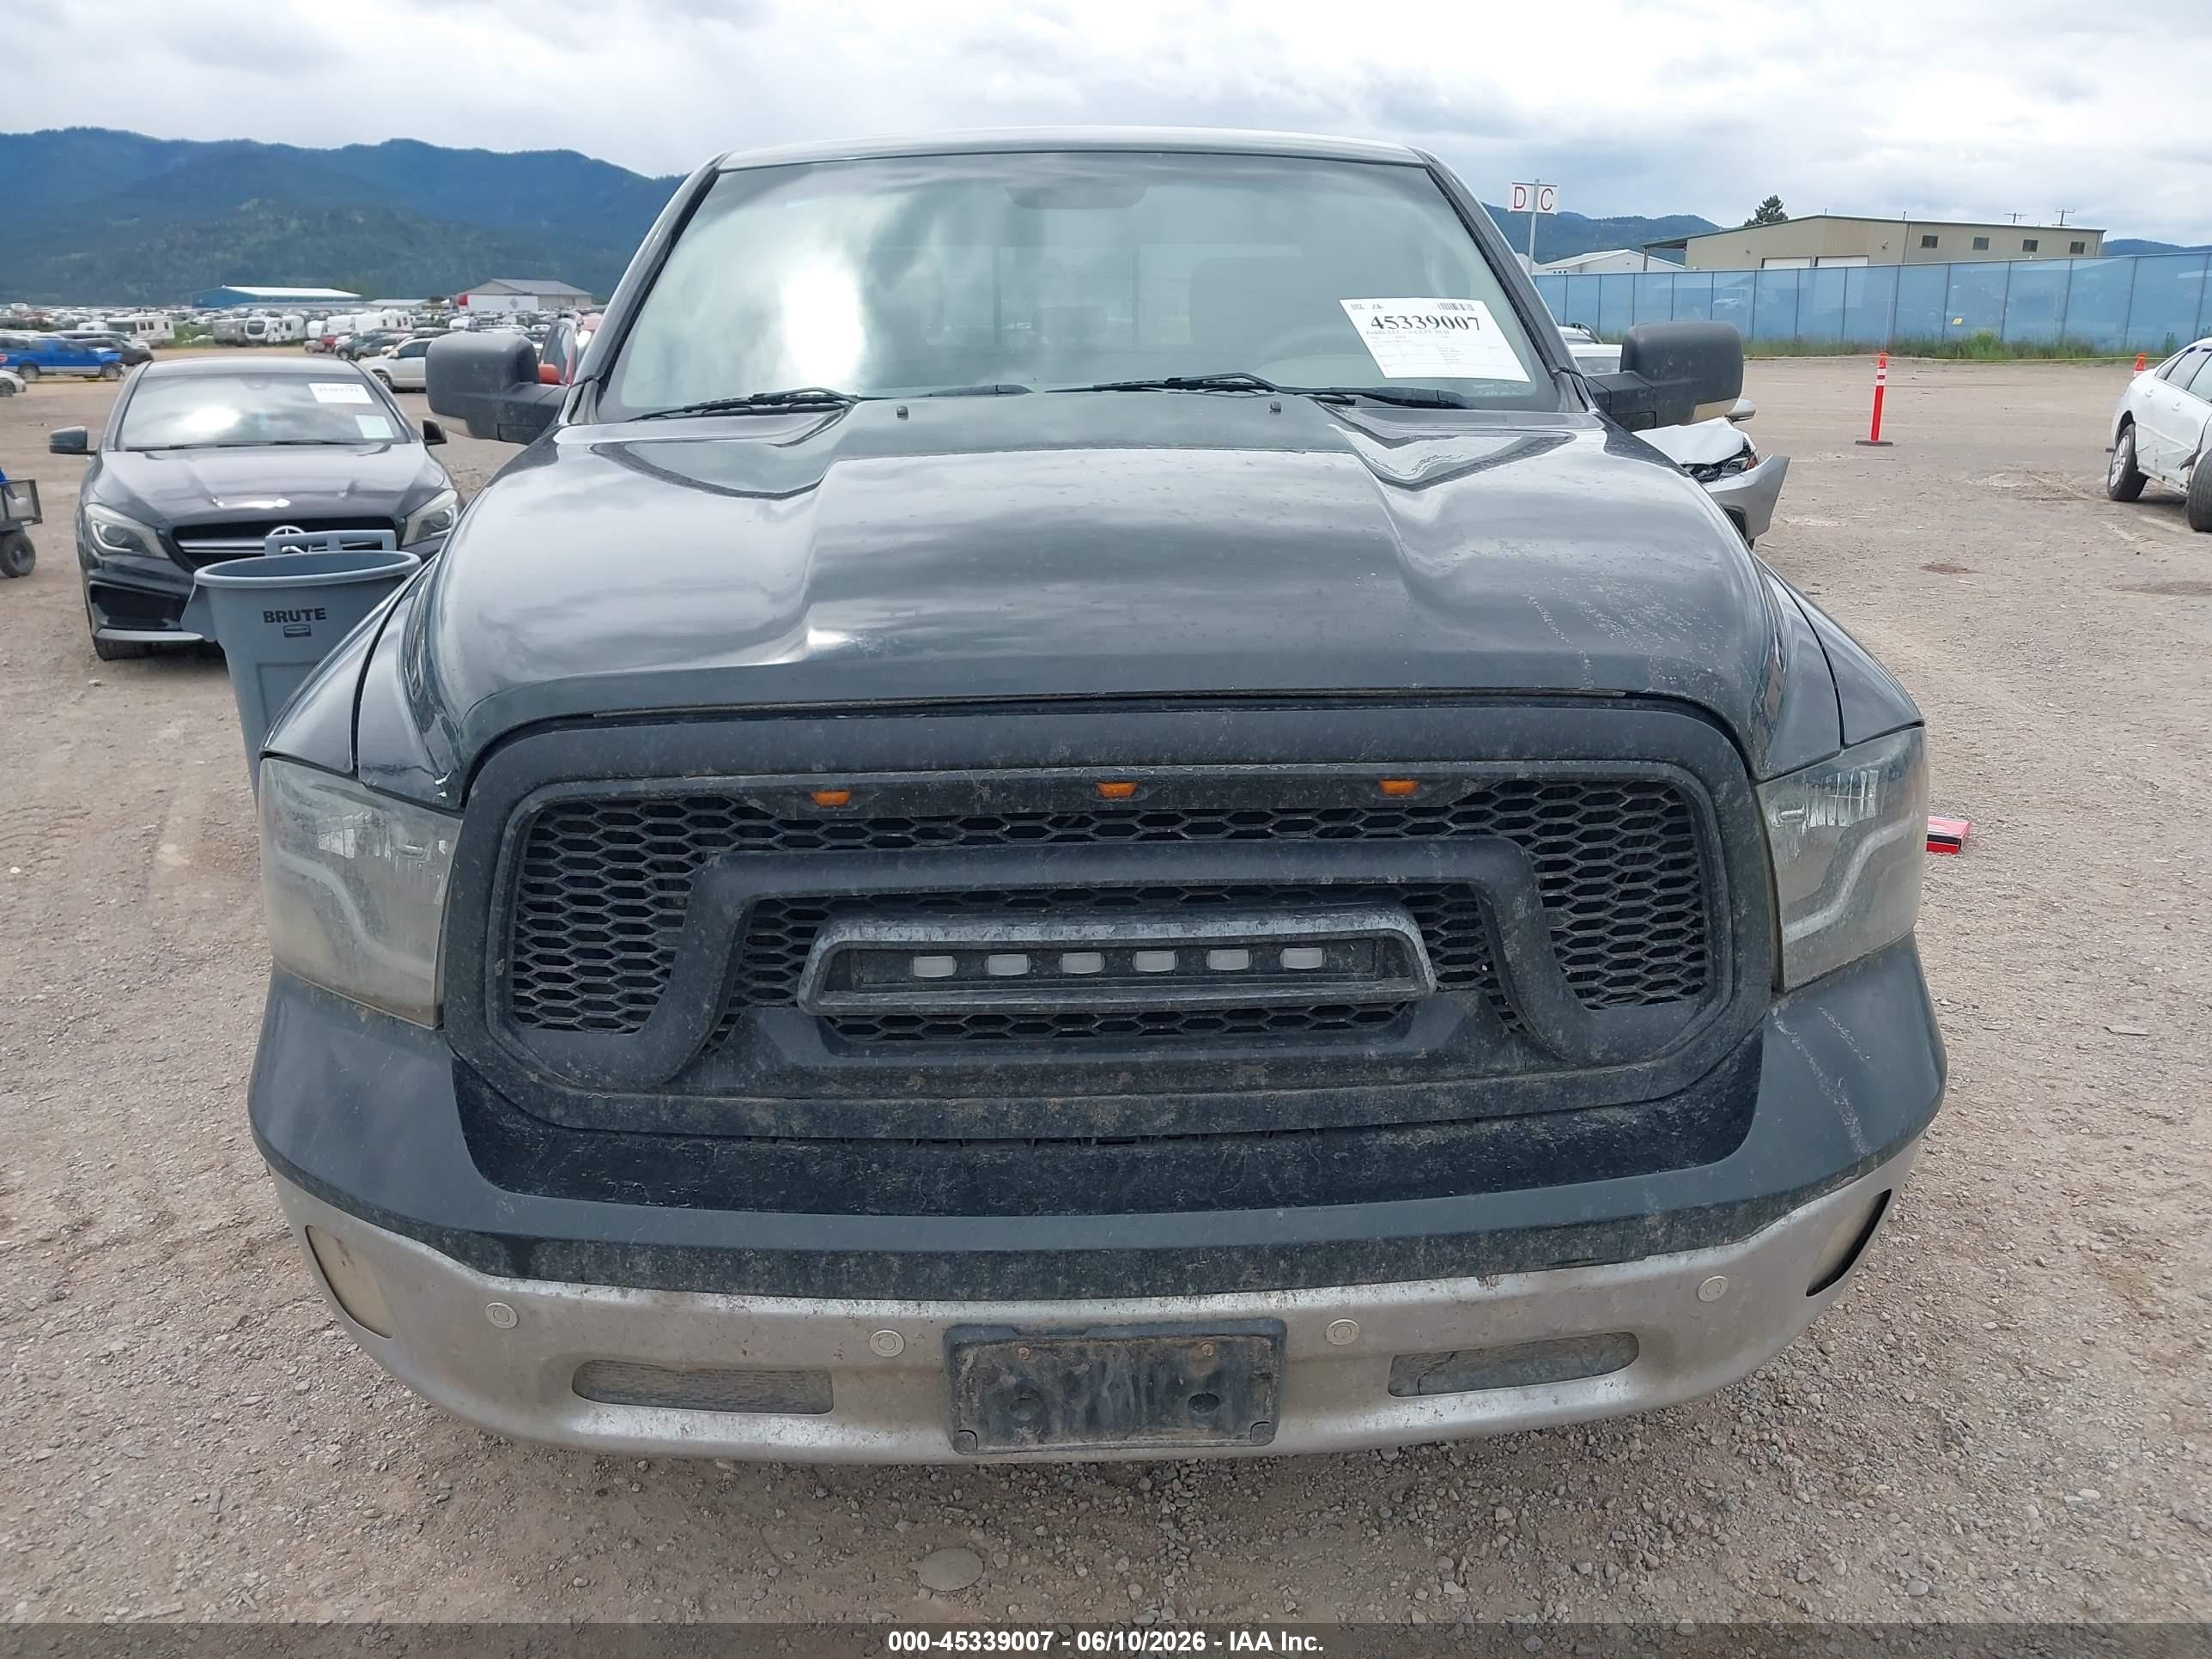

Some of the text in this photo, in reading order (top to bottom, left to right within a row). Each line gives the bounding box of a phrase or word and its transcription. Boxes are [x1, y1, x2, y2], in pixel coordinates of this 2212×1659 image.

[1513, 185, 1554, 211] D C
[1370, 314, 1481, 331] 45339007
[263, 607, 327, 623] BRUTE
